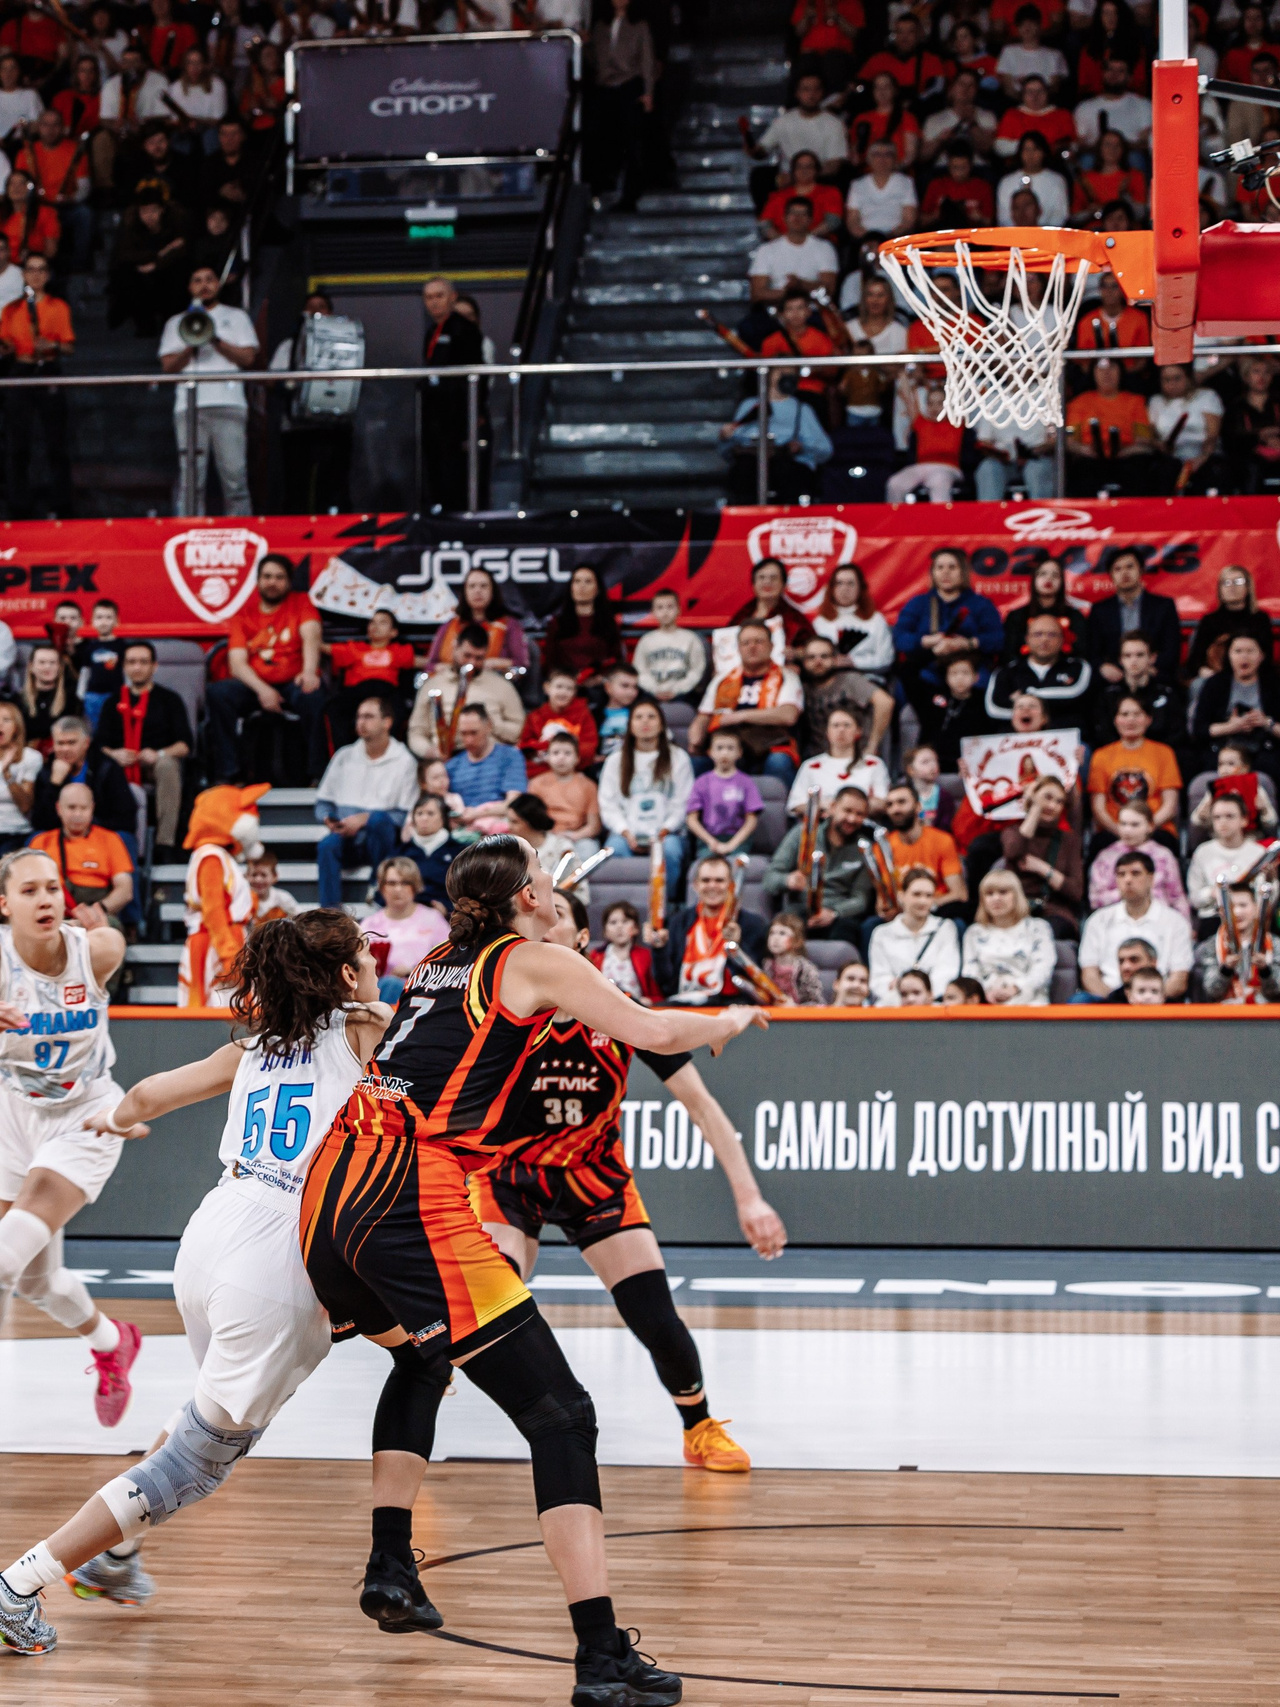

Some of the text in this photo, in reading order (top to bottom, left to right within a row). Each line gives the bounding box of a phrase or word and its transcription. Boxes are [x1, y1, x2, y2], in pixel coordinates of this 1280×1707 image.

[369, 93, 496, 117] СПОРТ
[397, 541, 573, 587] JÖGEL
[6, 1008, 98, 1036] ИНАМО
[376, 996, 437, 1061] 7
[34, 1040, 70, 1069] 97
[240, 1082, 314, 1162] 55
[543, 1097, 584, 1126] 38
[754, 1090, 896, 1171] САМЫЙ
[907, 1091, 1147, 1177] ДОСТУПНЫЙ
[1162, 1102, 1243, 1179] ВИД
